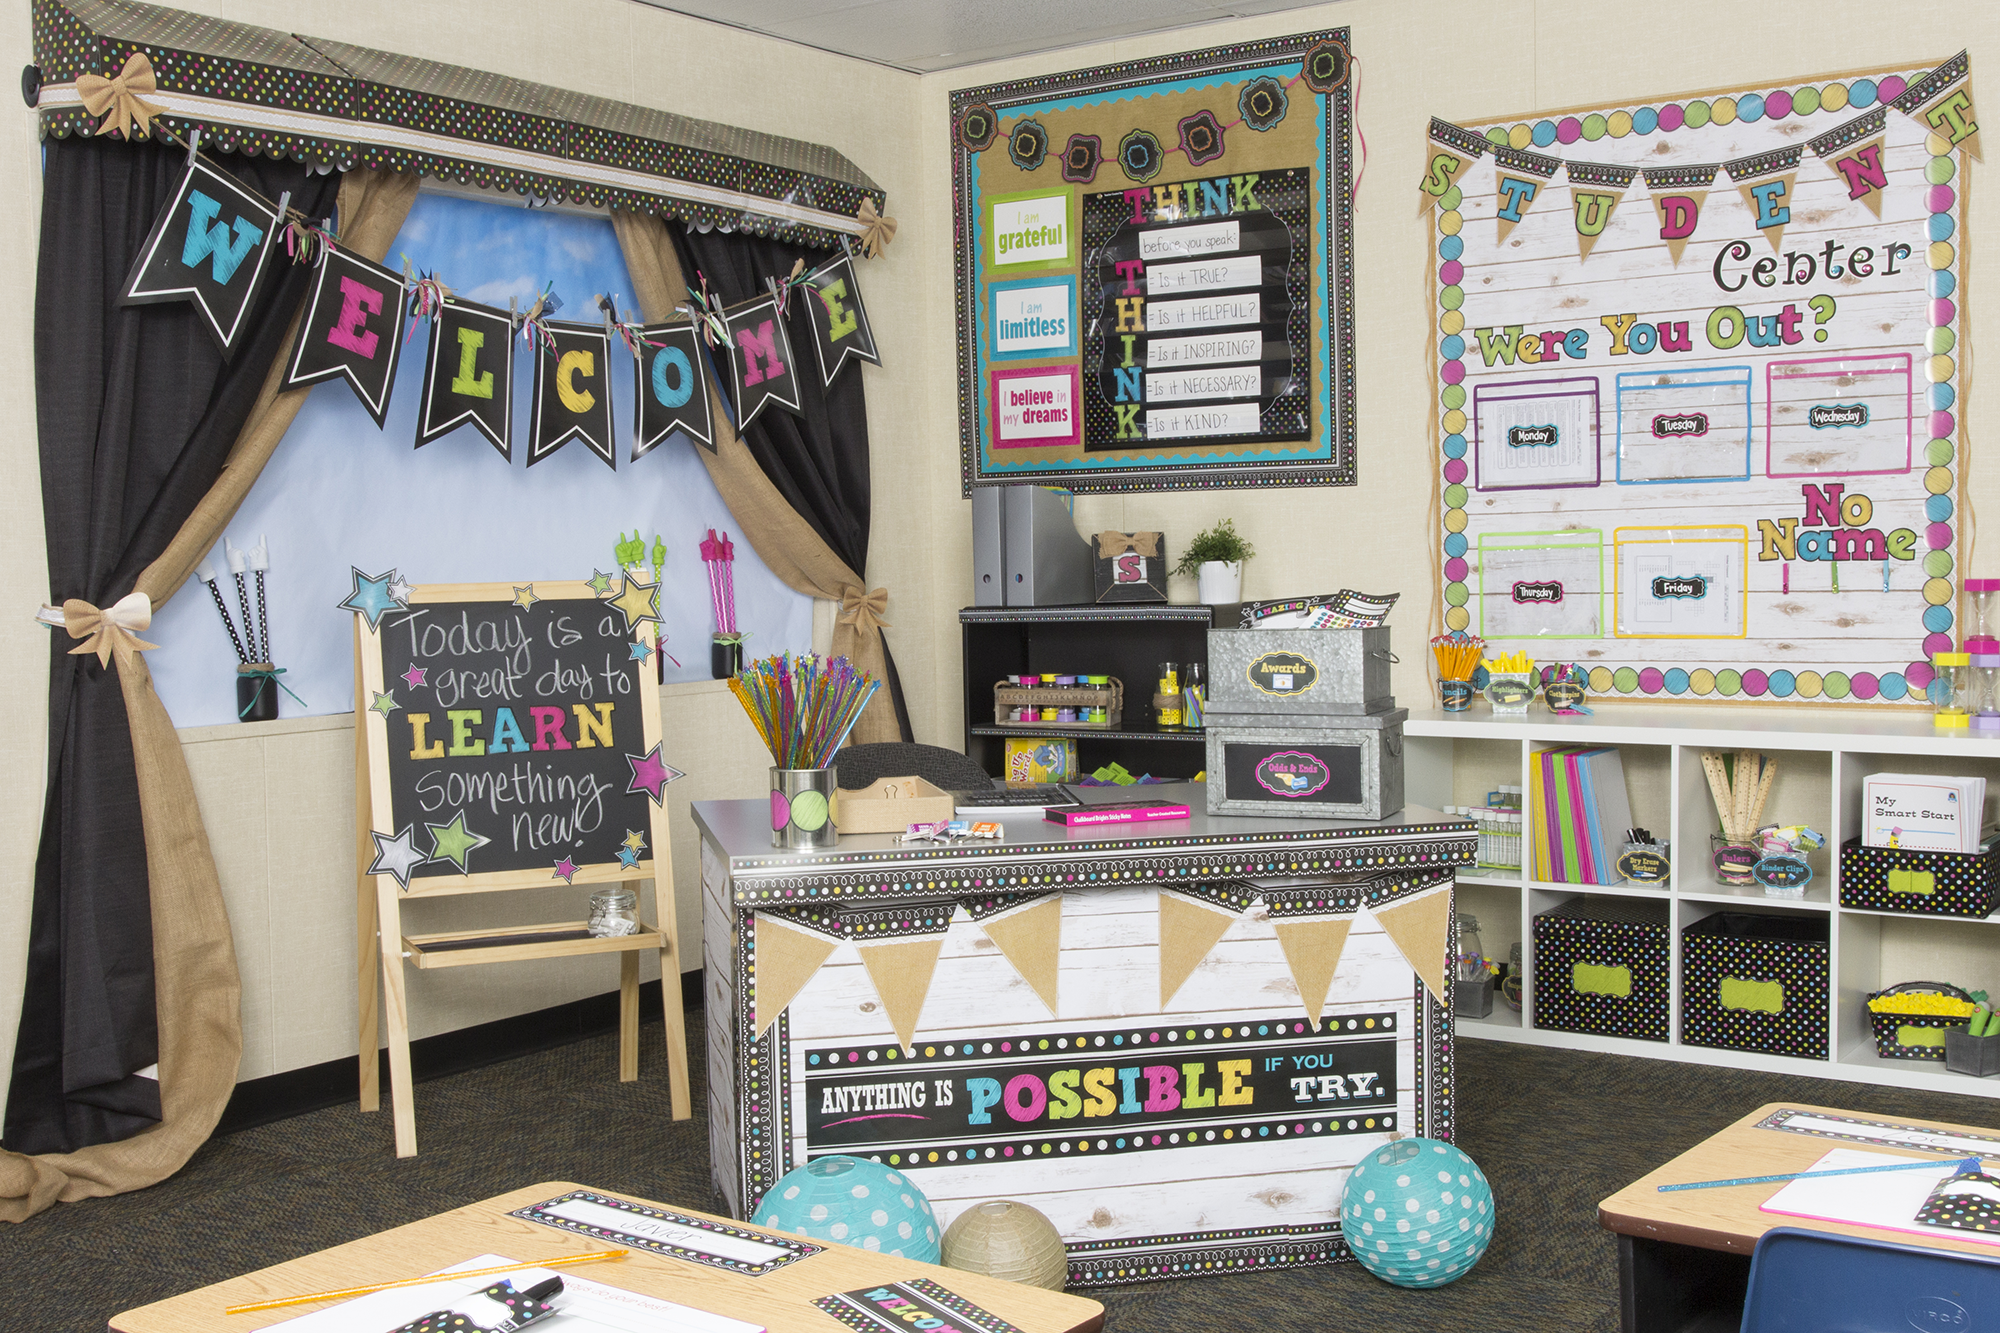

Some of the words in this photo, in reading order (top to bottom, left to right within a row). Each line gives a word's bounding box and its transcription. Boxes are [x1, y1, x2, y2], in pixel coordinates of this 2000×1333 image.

[1424, 90, 1979, 240] STUDENT
[1123, 173, 1262, 225] THINK
[1017, 211, 1021, 225] I
[1023, 213, 1039, 224] am
[998, 223, 1062, 254] grateful
[1142, 236, 1180, 254] before
[1184, 240, 1202, 252] you
[1712, 239, 1912, 293] Center
[1158, 272, 1170, 287] Is
[1178, 271, 1187, 285] it
[1189, 267, 1228, 285] TRUE?
[181, 188, 858, 414] WELCOME
[1020, 301, 1024, 315] I
[1026, 303, 1042, 314] am
[1158, 309, 1170, 325] Is
[1177, 309, 1186, 323] it
[999, 316, 1066, 340] limitless
[1474, 325, 1590, 368] Were
[1601, 313, 1693, 355] You
[1705, 294, 1837, 350] Out?
[1158, 346, 1168, 361] Is
[1171, 347, 1178, 360] it
[1183, 339, 1256, 360] INSPIRING?
[1170, 380, 1178, 395] it
[1183, 375, 1257, 394] NECESSARY?
[1003, 391, 1007, 406] I
[1010, 389, 1054, 407] believe
[1056, 389, 1067, 403] in
[1003, 413, 1019, 427] my
[1022, 407, 1068, 424] dreams
[1170, 416, 1180, 431] it
[1184, 413, 1229, 431] KIND?
[1661, 419, 1697, 432] Tuesday
[1814, 411, 1860, 423] Wednesday
[1518, 431, 1549, 443] Monday
[1802, 483, 1873, 527] No
[1757, 517, 1917, 563] Name
[1118, 555, 1141, 583] S
[1519, 586, 1554, 599] Thursday
[1663, 582, 1693, 594] Friday
[1256, 601, 1304, 618] AMAZING
[389, 609, 532, 676] Today
[547, 610, 583, 649] is
[598, 616, 621, 637] a
[1260, 662, 1307, 674] Awards
[435, 655, 523, 708] great
[535, 658, 593, 700] day
[599, 653, 631, 695] to
[1491, 685, 1529, 695] Highlighters
[407, 701, 616, 761] LEARN
[1268, 762, 1288, 773] Odds
[1298, 763, 1318, 774] Ends
[1875, 796, 1897, 807] My
[1875, 807, 1917, 818] Smart
[1921, 810, 1955, 821] Start
[1629, 856, 1641, 866] Dry
[1722, 853, 1751, 863] Rulers
[1761, 864, 1784, 872] Binder
[1785, 865, 1804, 873] Clips
[1265, 1057, 1284, 1072] IF
[1291, 1053, 1334, 1070] YOU
[820, 1080, 926, 1114] ANYTHING
[934, 1079, 954, 1107] IS
[965, 1058, 1255, 1126] POSSIBLE
[1290, 1072, 1386, 1103] TRY.
[620, 1217, 703, 1242] Javier
[863, 1287, 965, 1333] WELCOM
